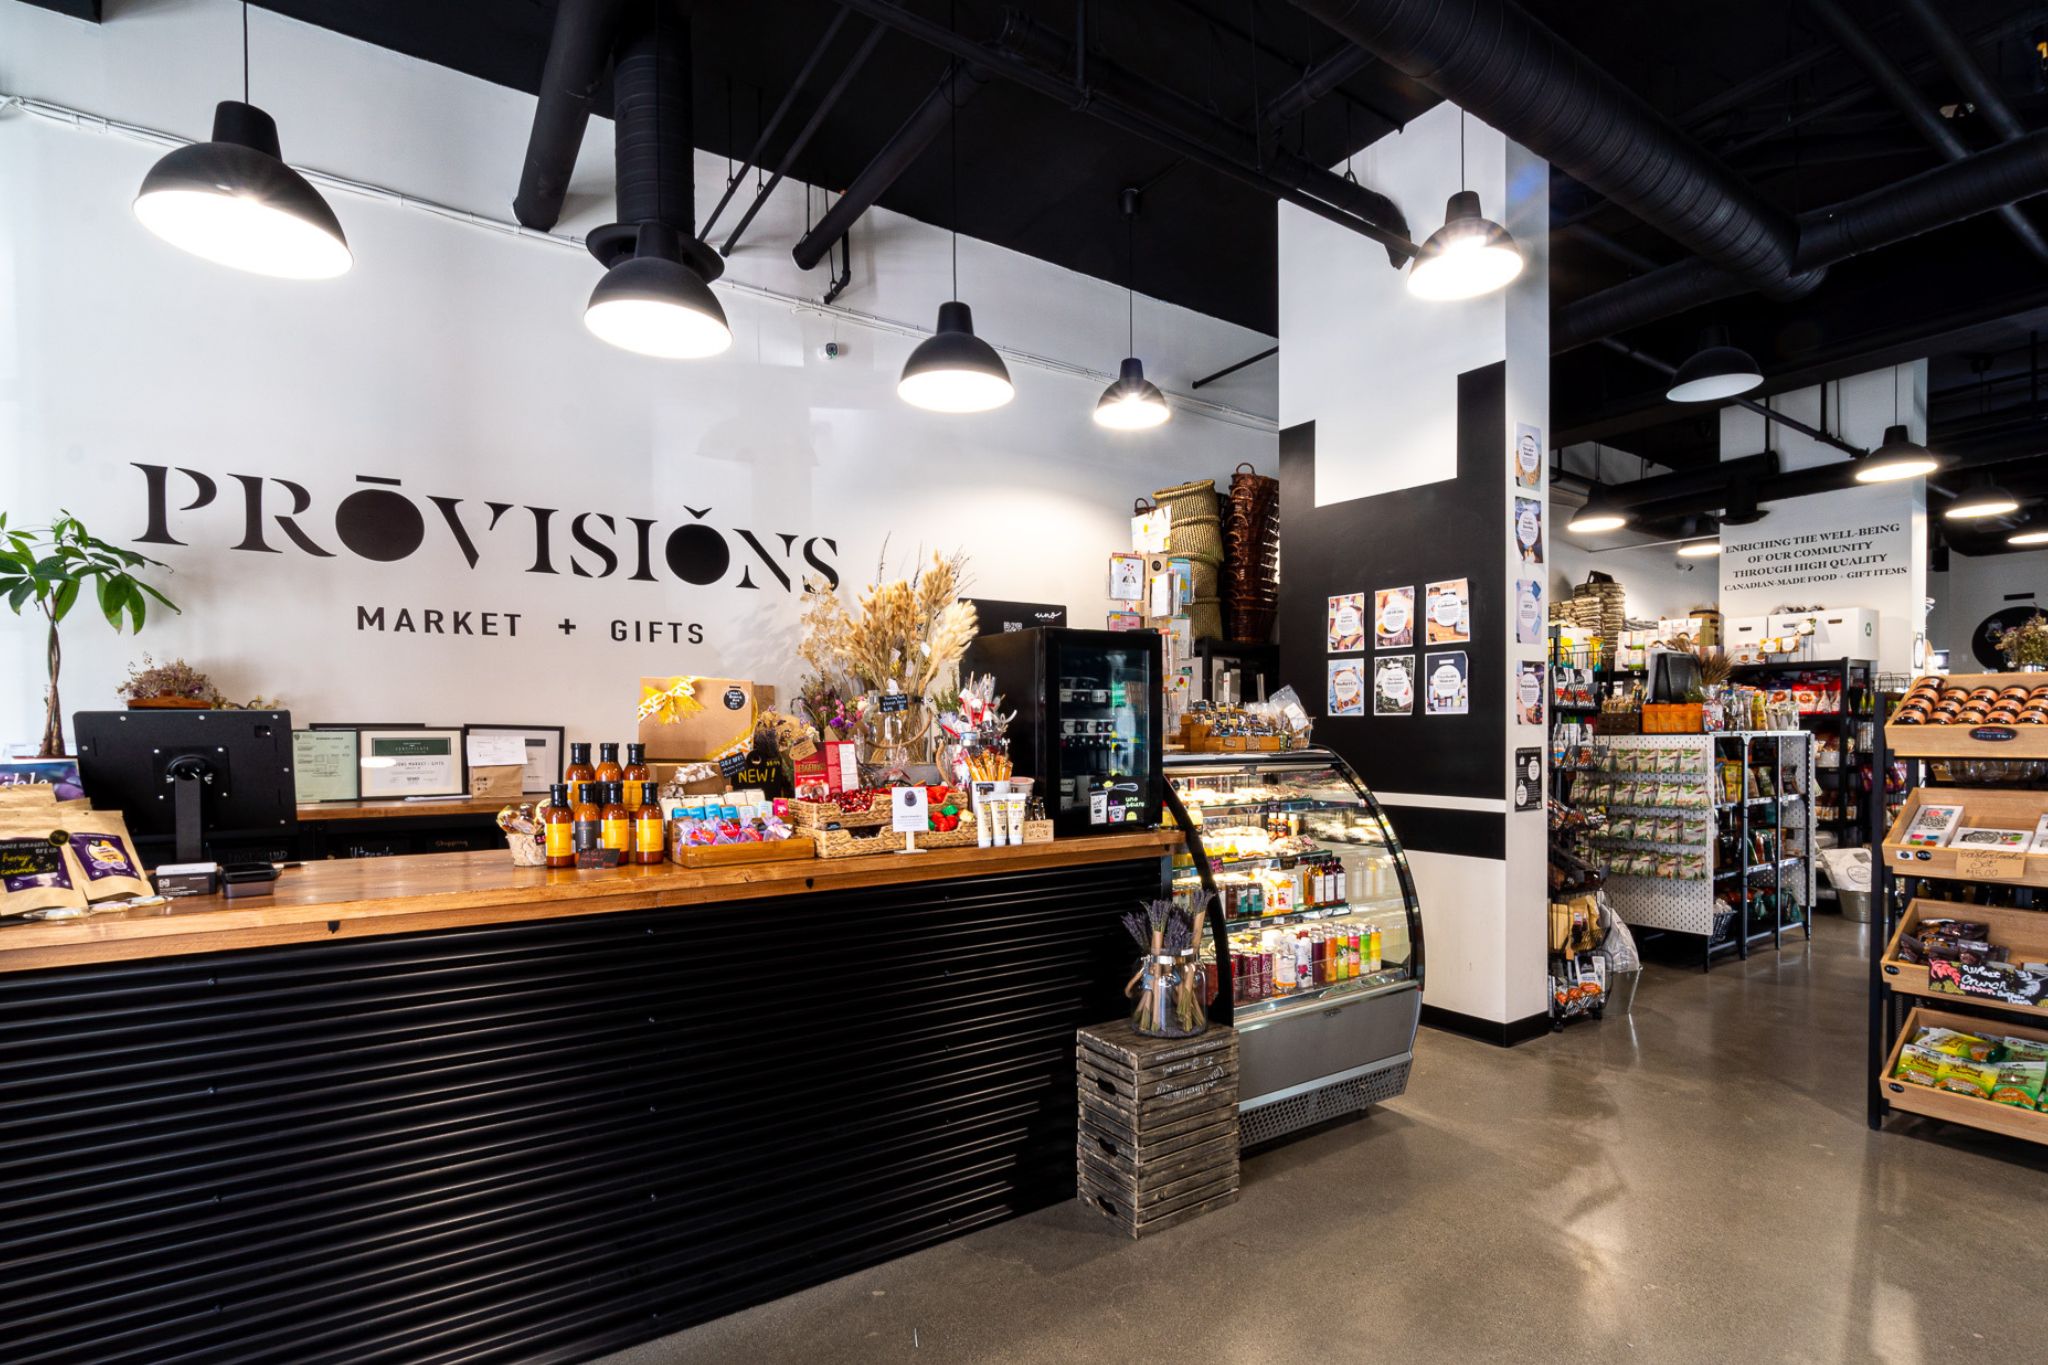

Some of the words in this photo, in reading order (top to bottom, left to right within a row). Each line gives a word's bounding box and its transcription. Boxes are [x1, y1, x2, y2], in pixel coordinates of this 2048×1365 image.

[1725, 538, 1791, 554] ENRICHING
[1793, 535, 1818, 545] THE
[1819, 523, 1900, 542] WELL-BEING
[1747, 554, 1764, 564] OF
[1765, 552, 1791, 562] OUR
[1793, 541, 1873, 559] COMMUNITY
[1733, 564, 1793, 578] THROUGH
[1794, 561, 1827, 572] HIGH
[1829, 553, 1888, 570] QUALITY
[1724, 577, 1806, 592] CANADIAN-MADE
[1807, 573, 1837, 583] FOOD
[1846, 570, 1873, 580] GIFT
[1873, 567, 1908, 577] ITEMS
[357, 605, 522, 640] MARKET
[557, 618, 577, 637] +
[610, 619, 706, 646] GIFTS
[738, 767, 776, 784] NEW!
[1961, 974, 2009, 991] Crunch
